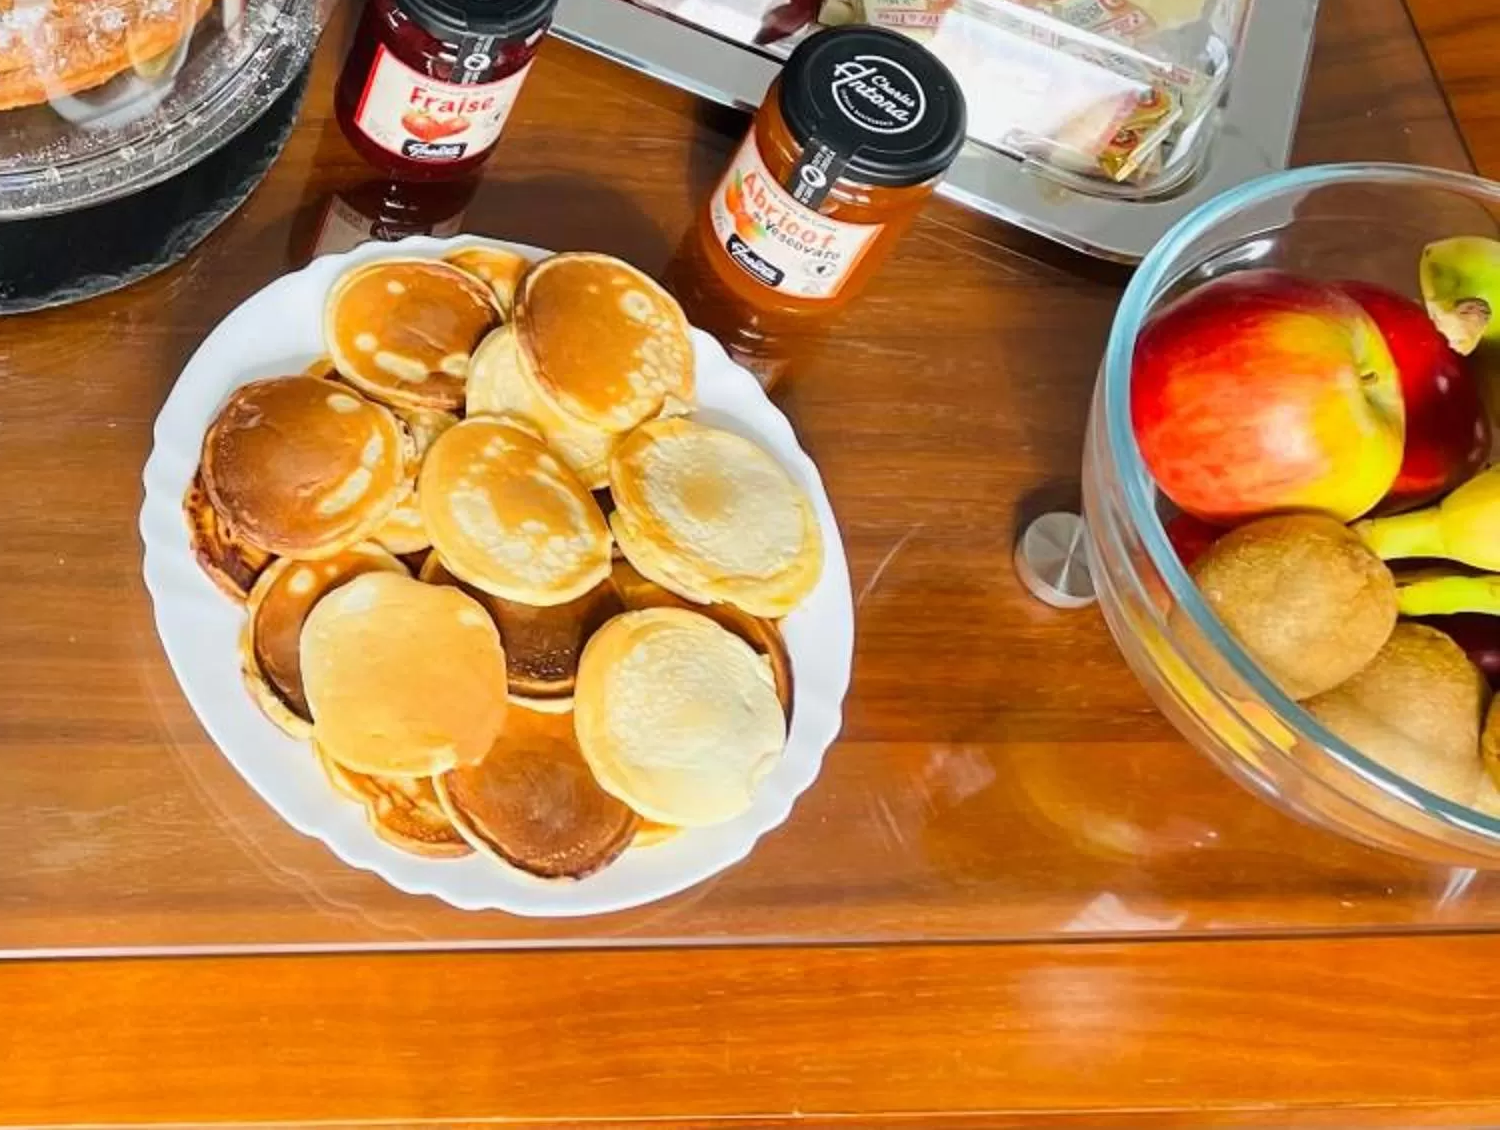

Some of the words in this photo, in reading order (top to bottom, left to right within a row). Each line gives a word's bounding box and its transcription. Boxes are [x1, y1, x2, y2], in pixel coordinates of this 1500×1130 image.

[409, 85, 495, 118] Fraise
[833, 62, 911, 122] Antona
[871, 75, 915, 107] Charles
[743, 171, 836, 248] Abricot
